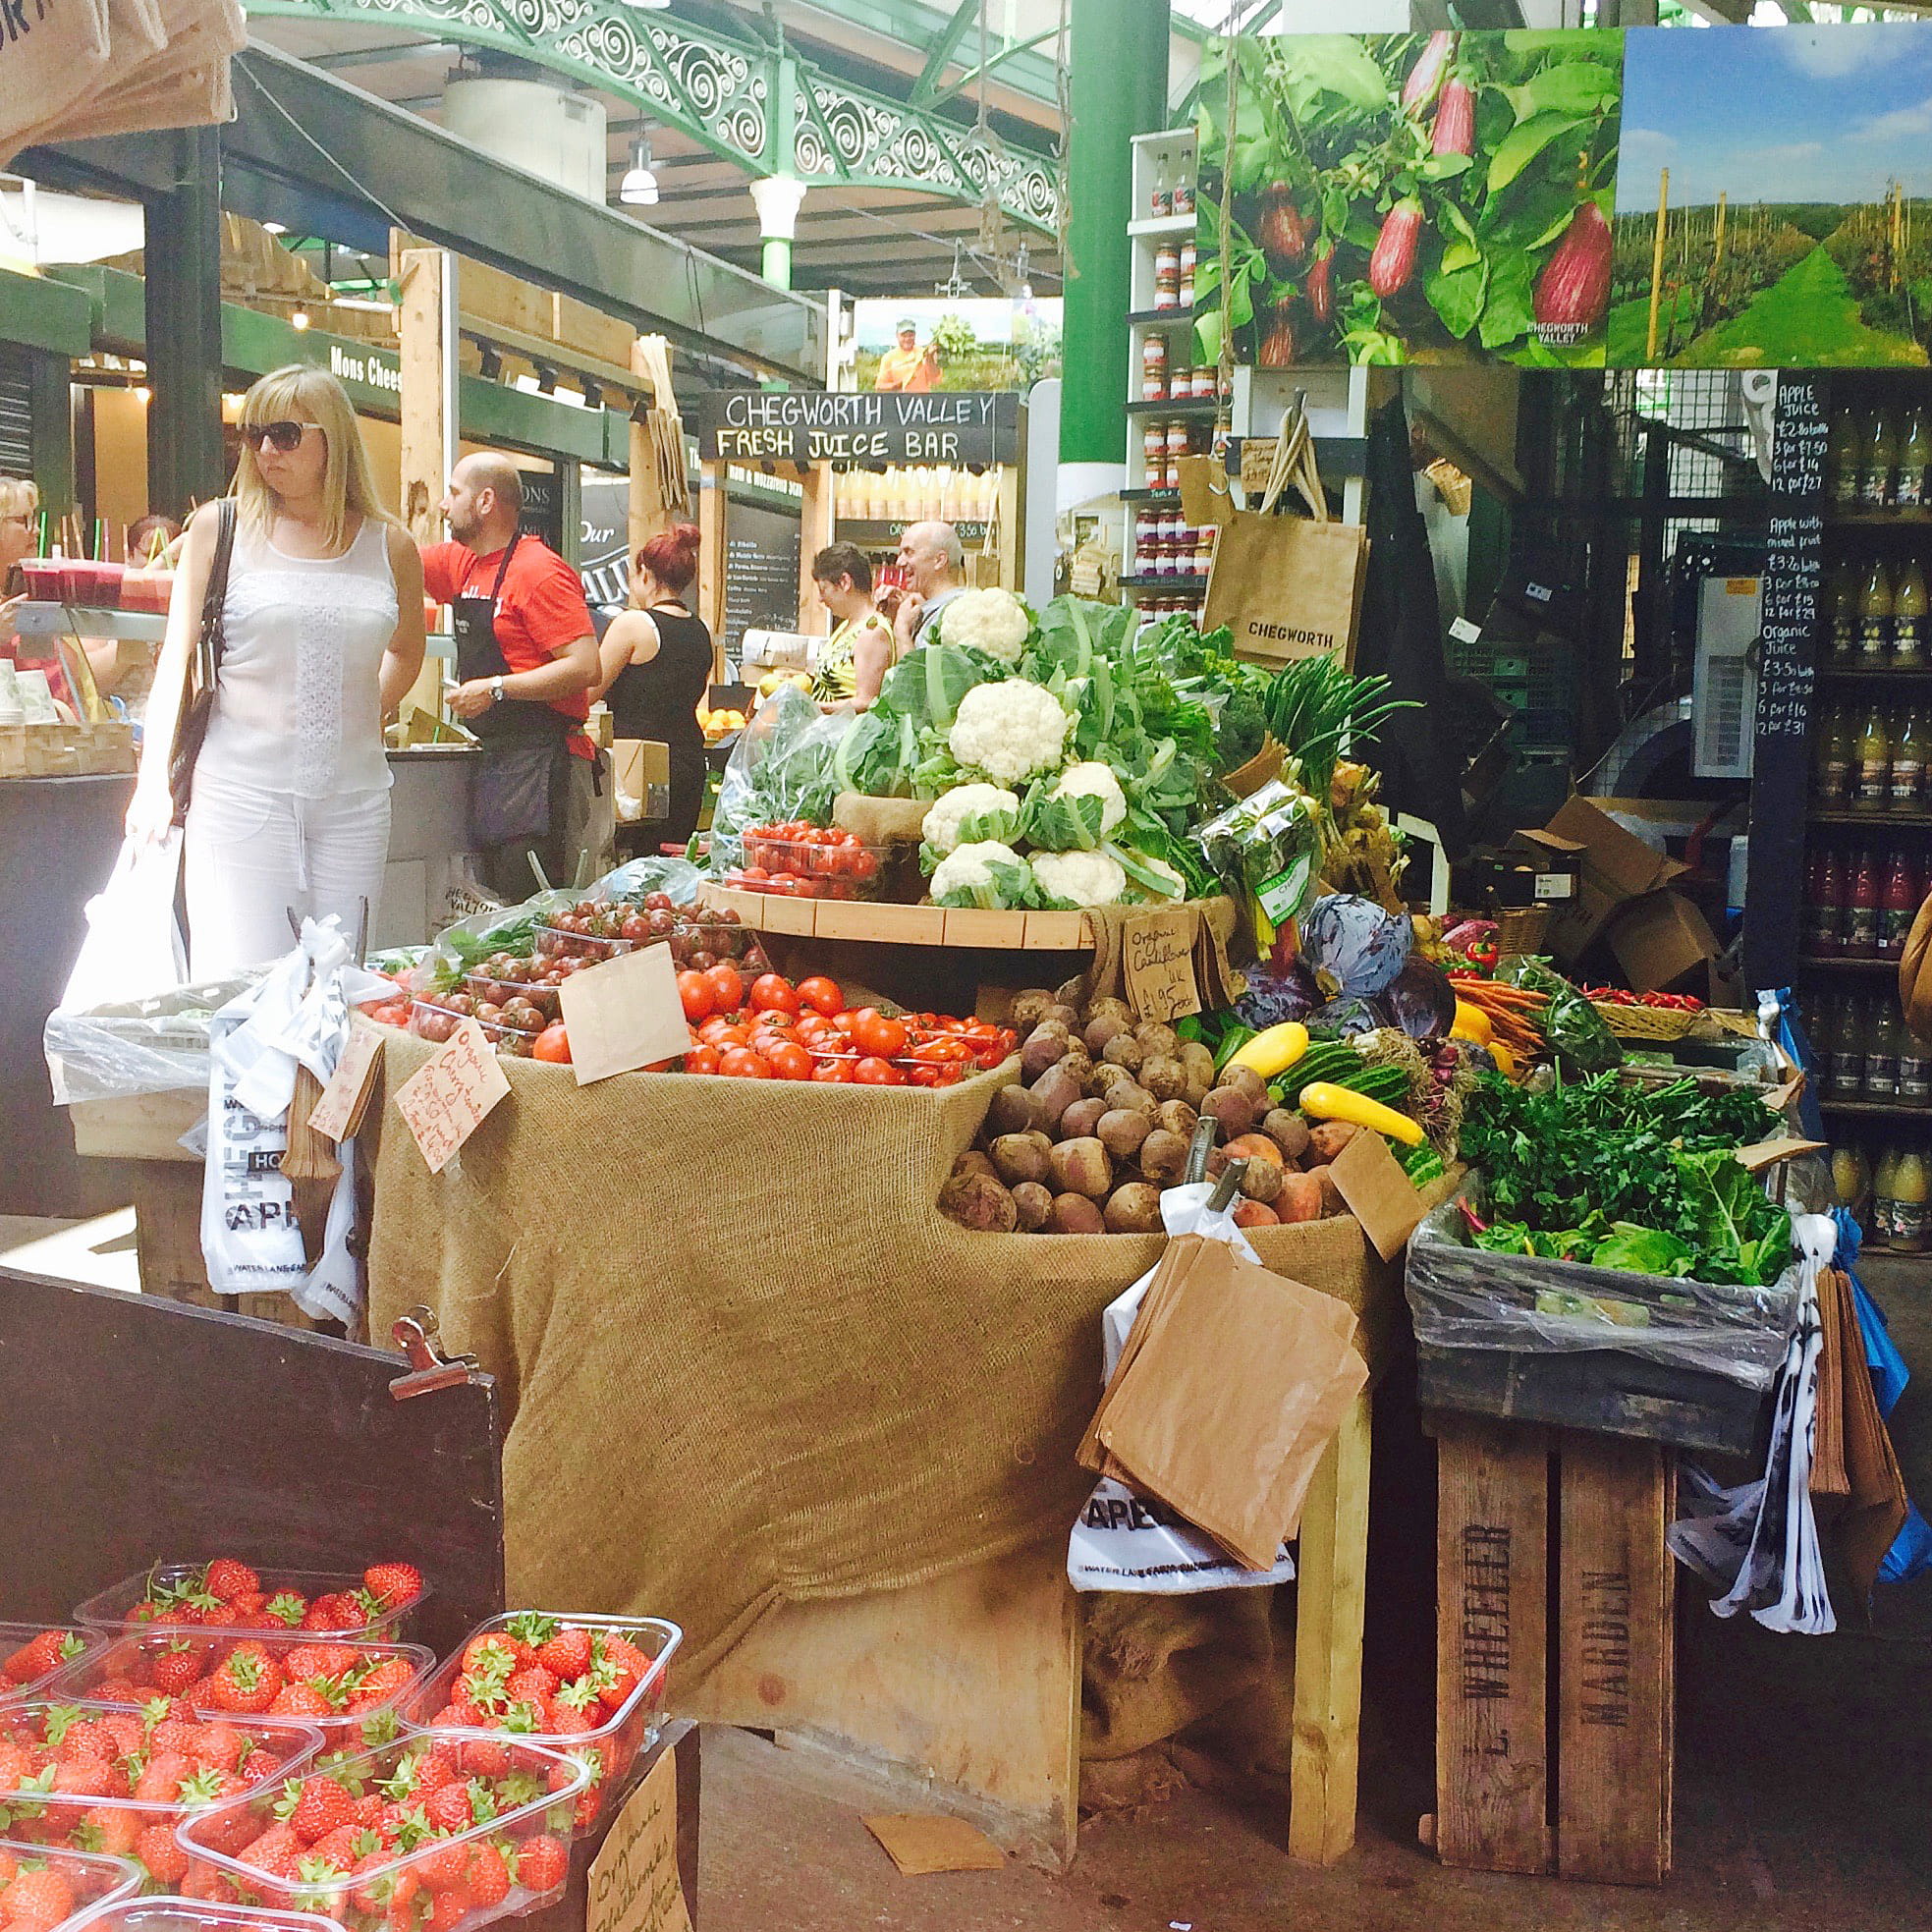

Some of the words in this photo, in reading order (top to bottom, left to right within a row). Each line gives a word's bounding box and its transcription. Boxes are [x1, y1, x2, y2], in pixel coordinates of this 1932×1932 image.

[1538, 333, 1575, 344] VALLEY
[330, 345, 364, 382] Mons
[726, 395, 882, 427] CHEGWORTH
[896, 394, 995, 426] VALLEY
[716, 429, 794, 459] FRESH
[807, 430, 890, 459] JUICE
[905, 431, 960, 460] BAR
[1775, 440, 1782, 456] 3
[1784, 442, 1796, 458] for
[689, 446, 701, 471] Th
[1773, 458, 1783, 472] 6
[1783, 459, 1797, 474] for
[1772, 477, 1785, 492] 12
[580, 554, 630, 603] ALU
[1764, 576, 1772, 590] 3
[1764, 592, 1773, 606] 6
[1248, 621, 1334, 649] CHEGWORTH
[1762, 624, 1811, 643] Organic
[1758, 698, 1766, 714] 6
[1755, 721, 1767, 736] 12
[253, 1154, 281, 1170] HO
[1463, 1523, 1511, 1699] WHEELER
[1580, 1572, 1631, 1728] MARDEN
